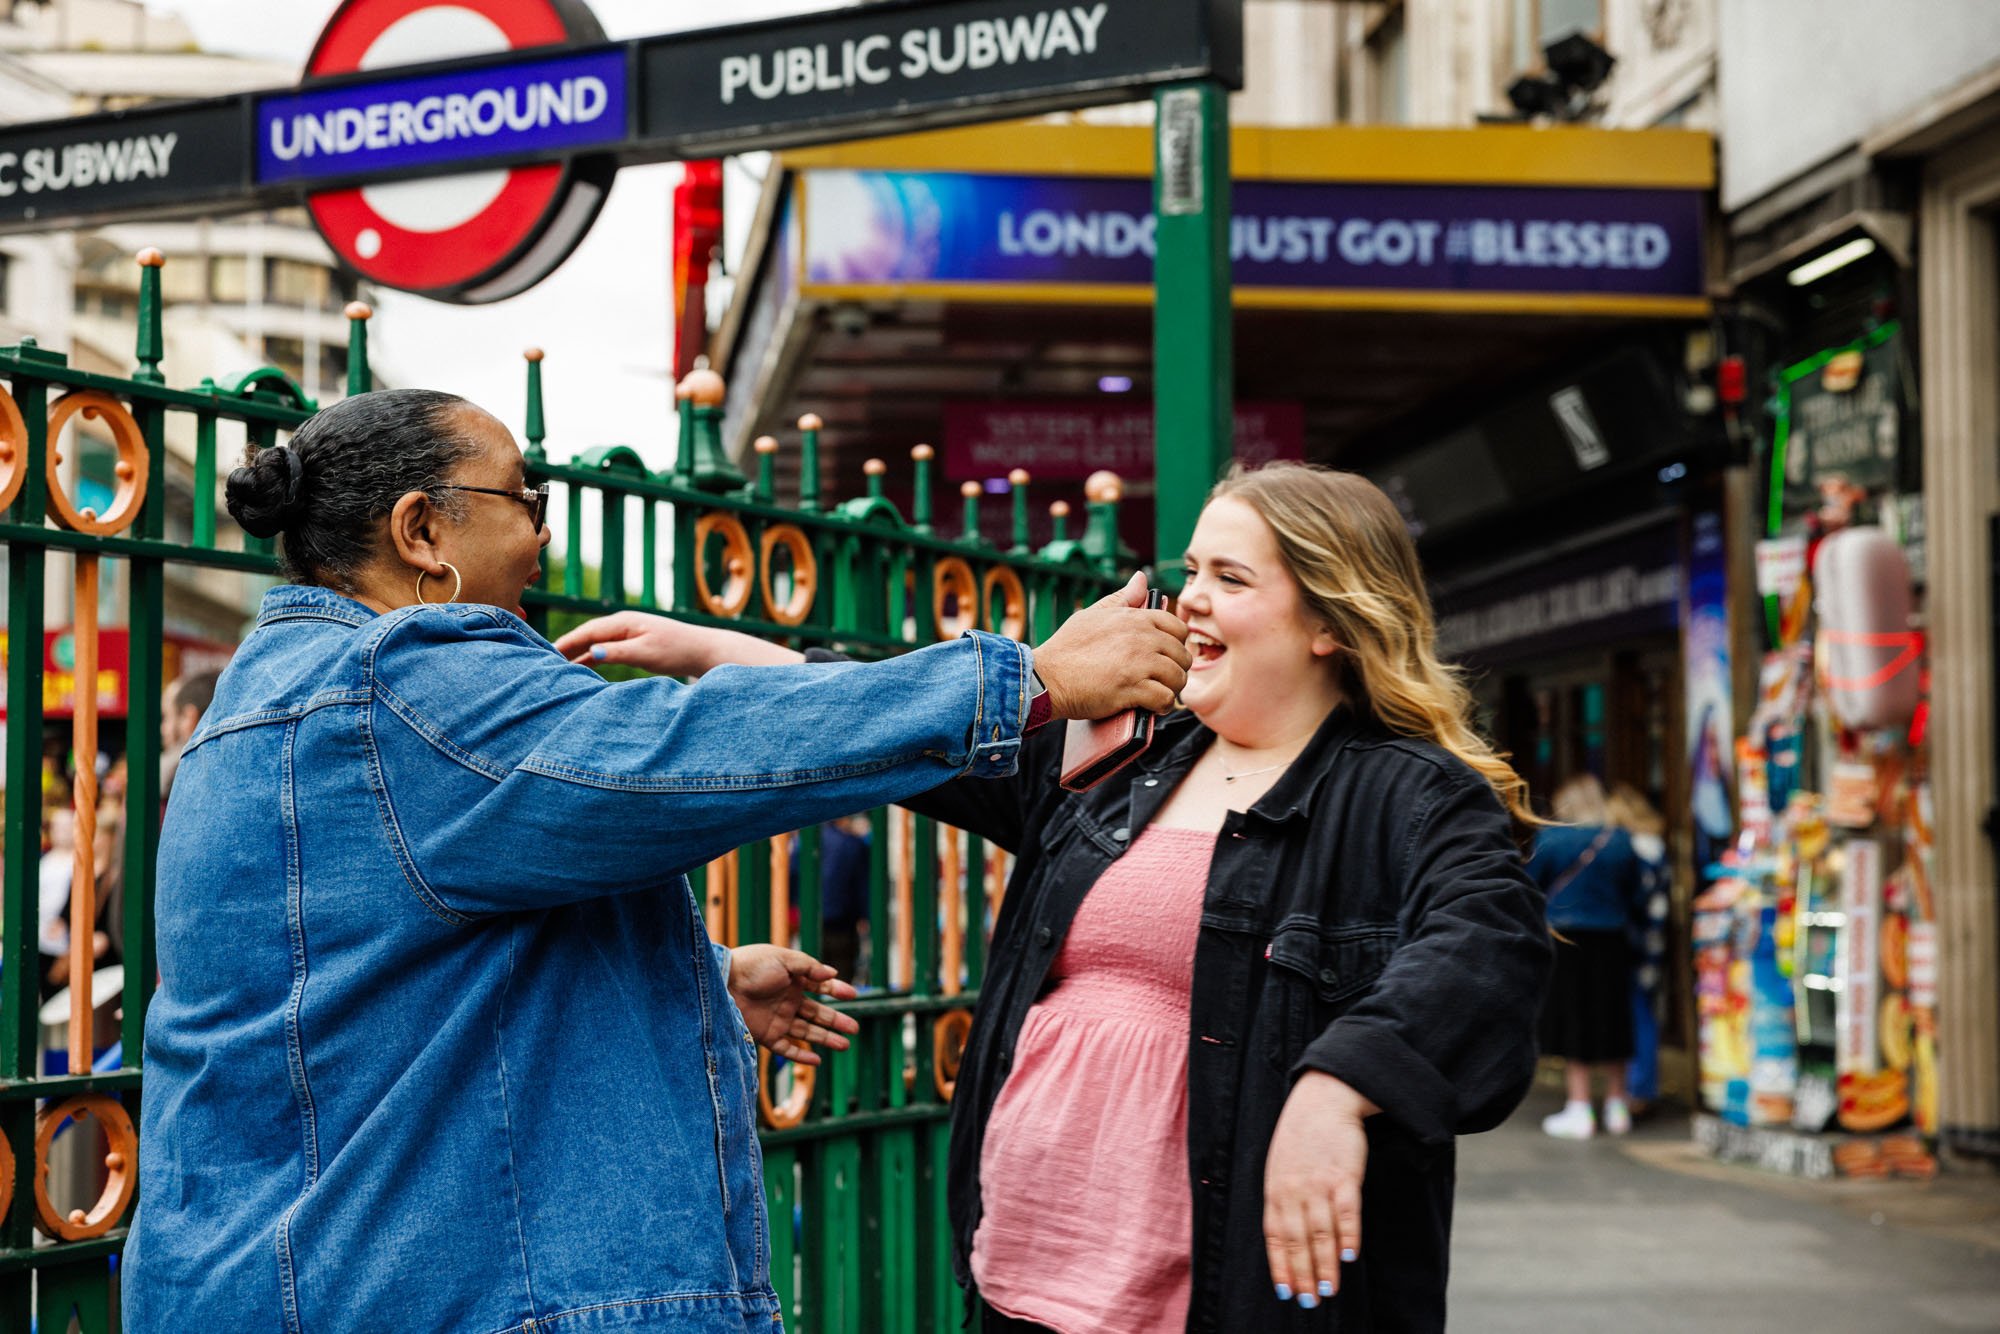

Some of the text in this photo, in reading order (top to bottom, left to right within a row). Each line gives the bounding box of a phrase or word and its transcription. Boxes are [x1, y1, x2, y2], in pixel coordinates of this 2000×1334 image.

[720, 3, 1107, 104] PUBLIC SUBWAY
[271, 76, 607, 160] UNDERGROUND
[22, 131, 178, 194] SUBWAY
[998, 209, 1670, 269] LONDO JUST GOT #BLESSED
